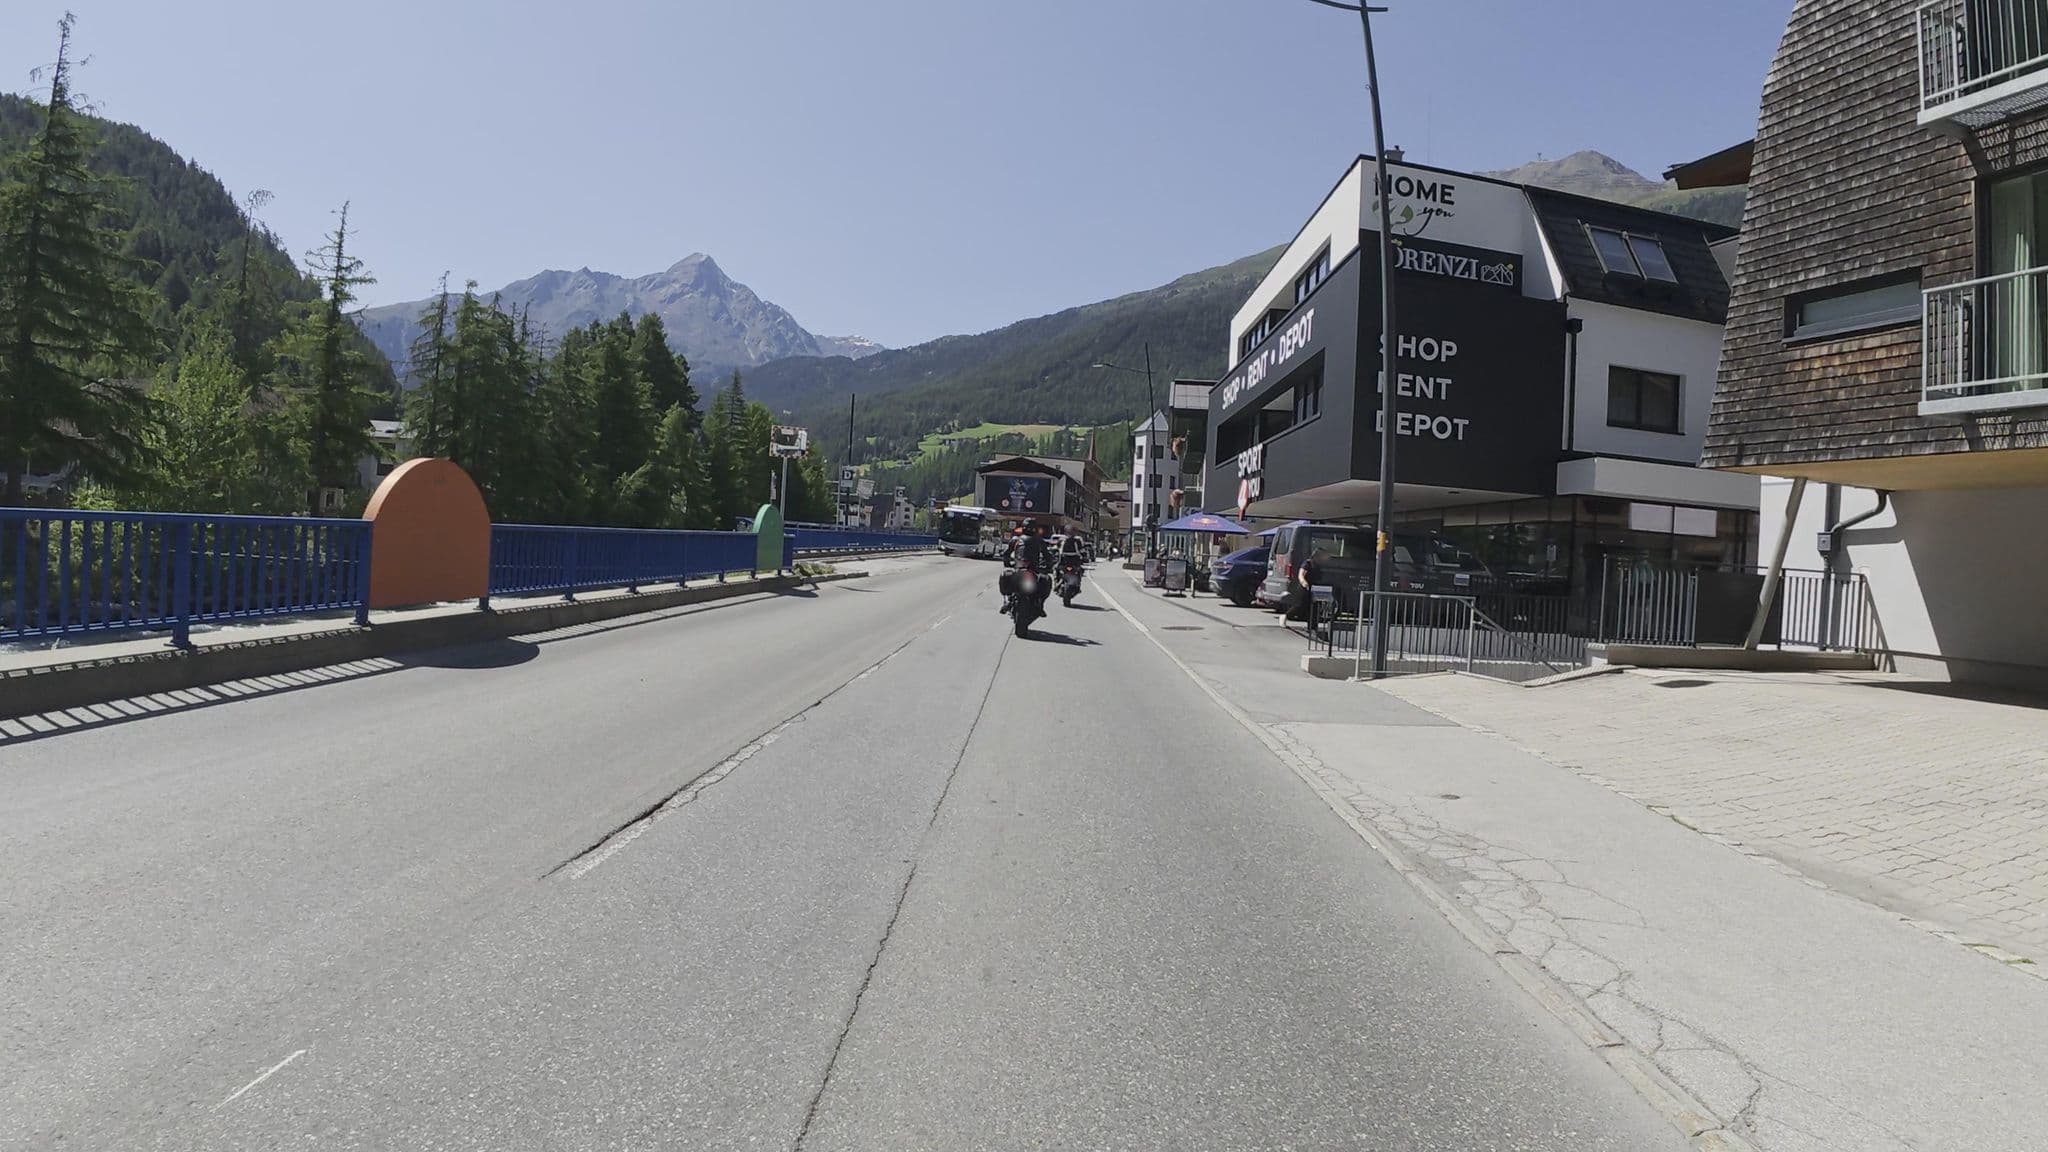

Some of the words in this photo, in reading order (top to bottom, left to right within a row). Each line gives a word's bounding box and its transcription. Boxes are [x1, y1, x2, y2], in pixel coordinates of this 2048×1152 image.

[1375, 173, 1455, 206] HOME
[1403, 206, 1455, 236] you
[1222, 376, 1240, 410] SHOP
[1246, 350, 1269, 391] RENT
[1279, 308, 1315, 365] DEPOT
[1379, 334, 1458, 362] HOP
[1238, 443, 1264, 478] SPORT
